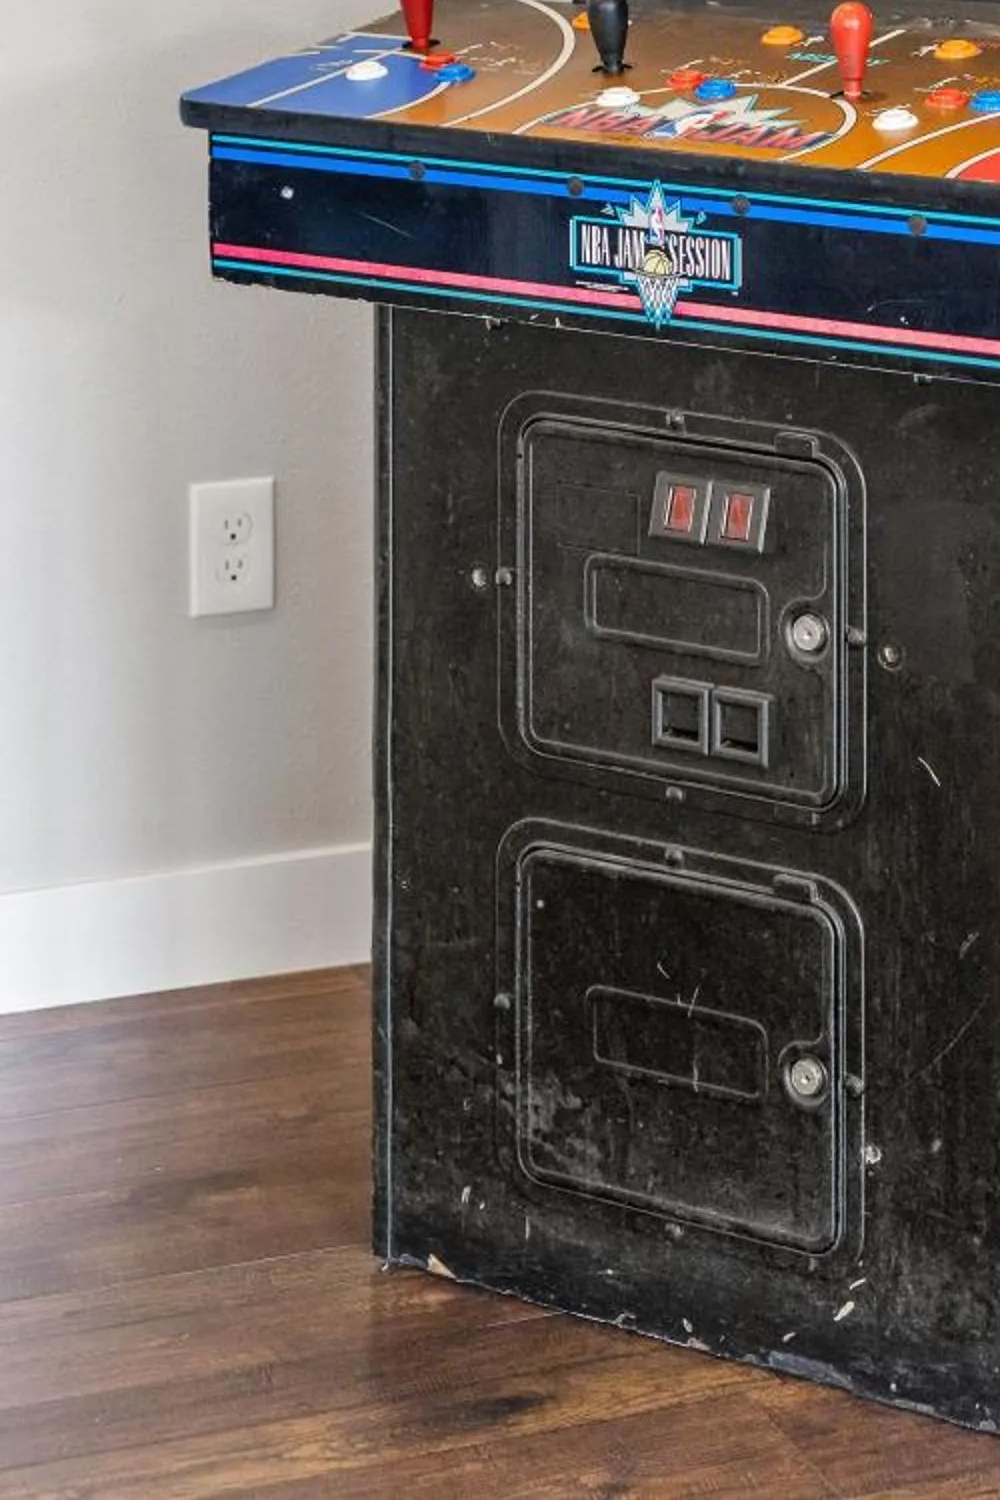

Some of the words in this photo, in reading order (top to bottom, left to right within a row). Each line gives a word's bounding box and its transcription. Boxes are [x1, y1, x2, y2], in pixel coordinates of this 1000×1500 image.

[580, 224, 611, 267] NBA
[614, 227, 646, 270] JAM
[668, 234, 731, 281] SESSION
